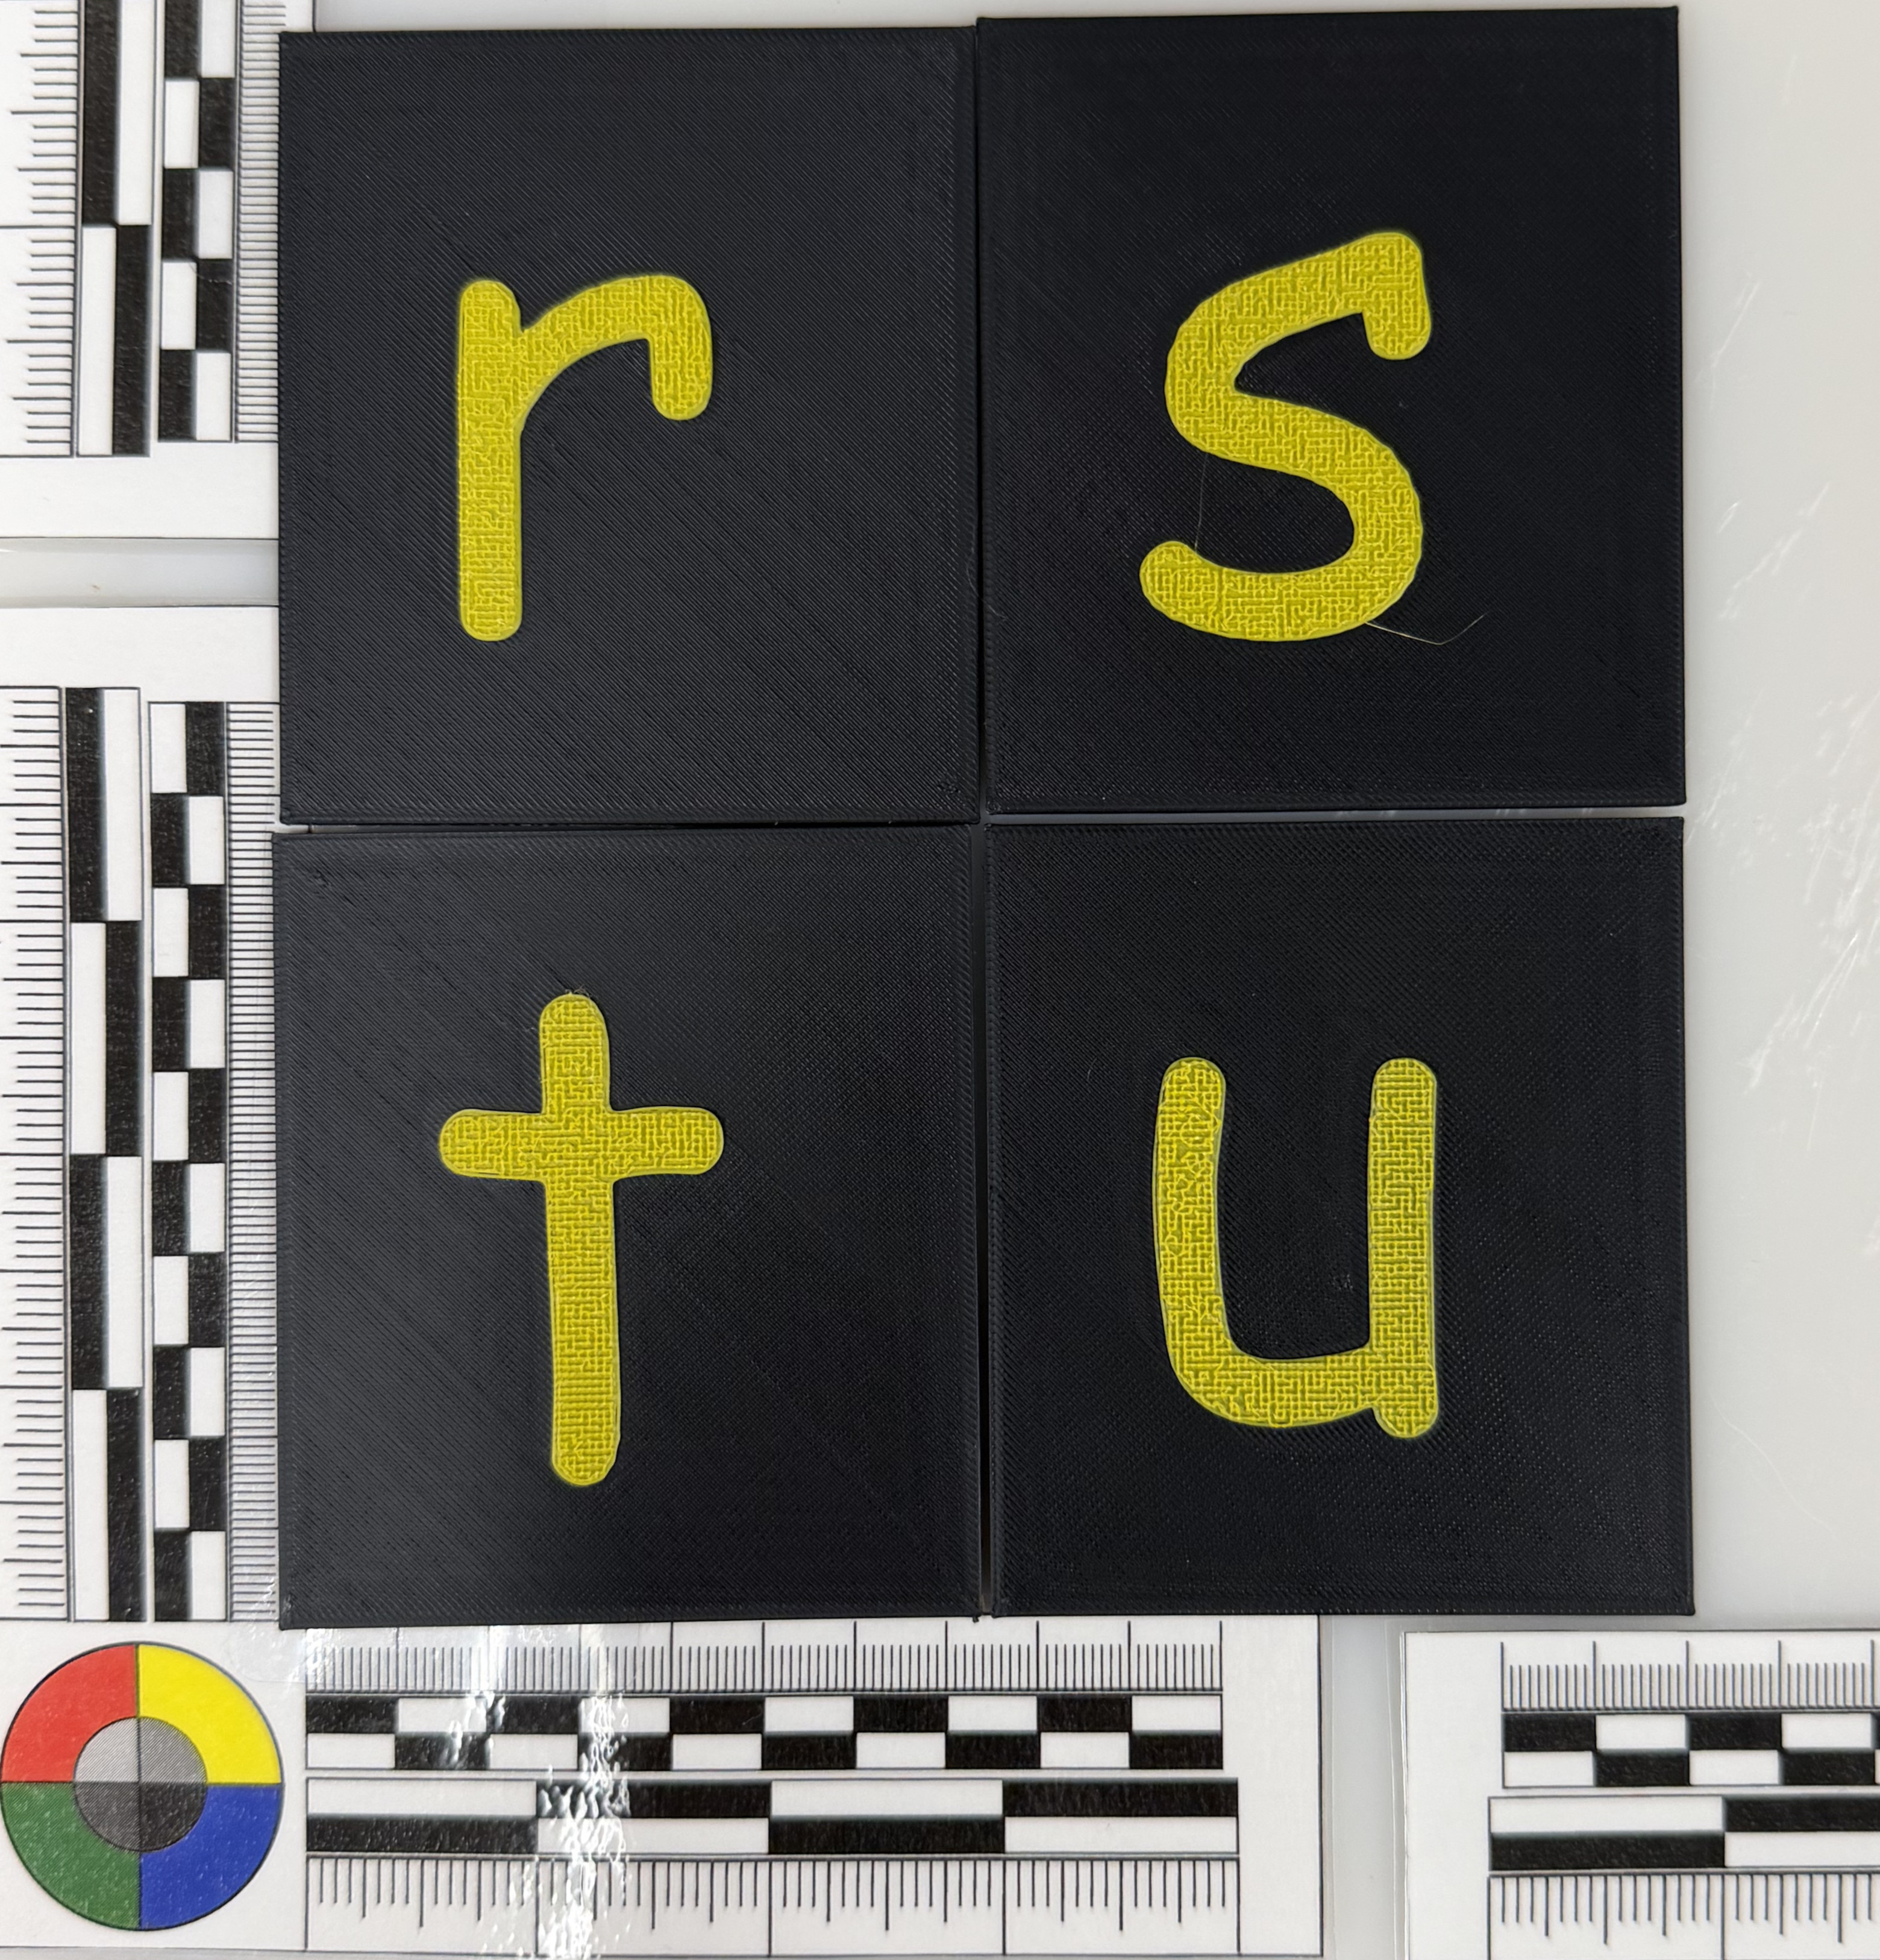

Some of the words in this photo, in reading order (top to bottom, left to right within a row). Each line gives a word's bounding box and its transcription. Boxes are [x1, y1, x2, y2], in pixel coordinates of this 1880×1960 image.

[456, 274, 712, 641] r
[1139, 232, 1431, 641] s
[438, 993, 723, 1487] t
[1152, 1058, 1439, 1439] u
